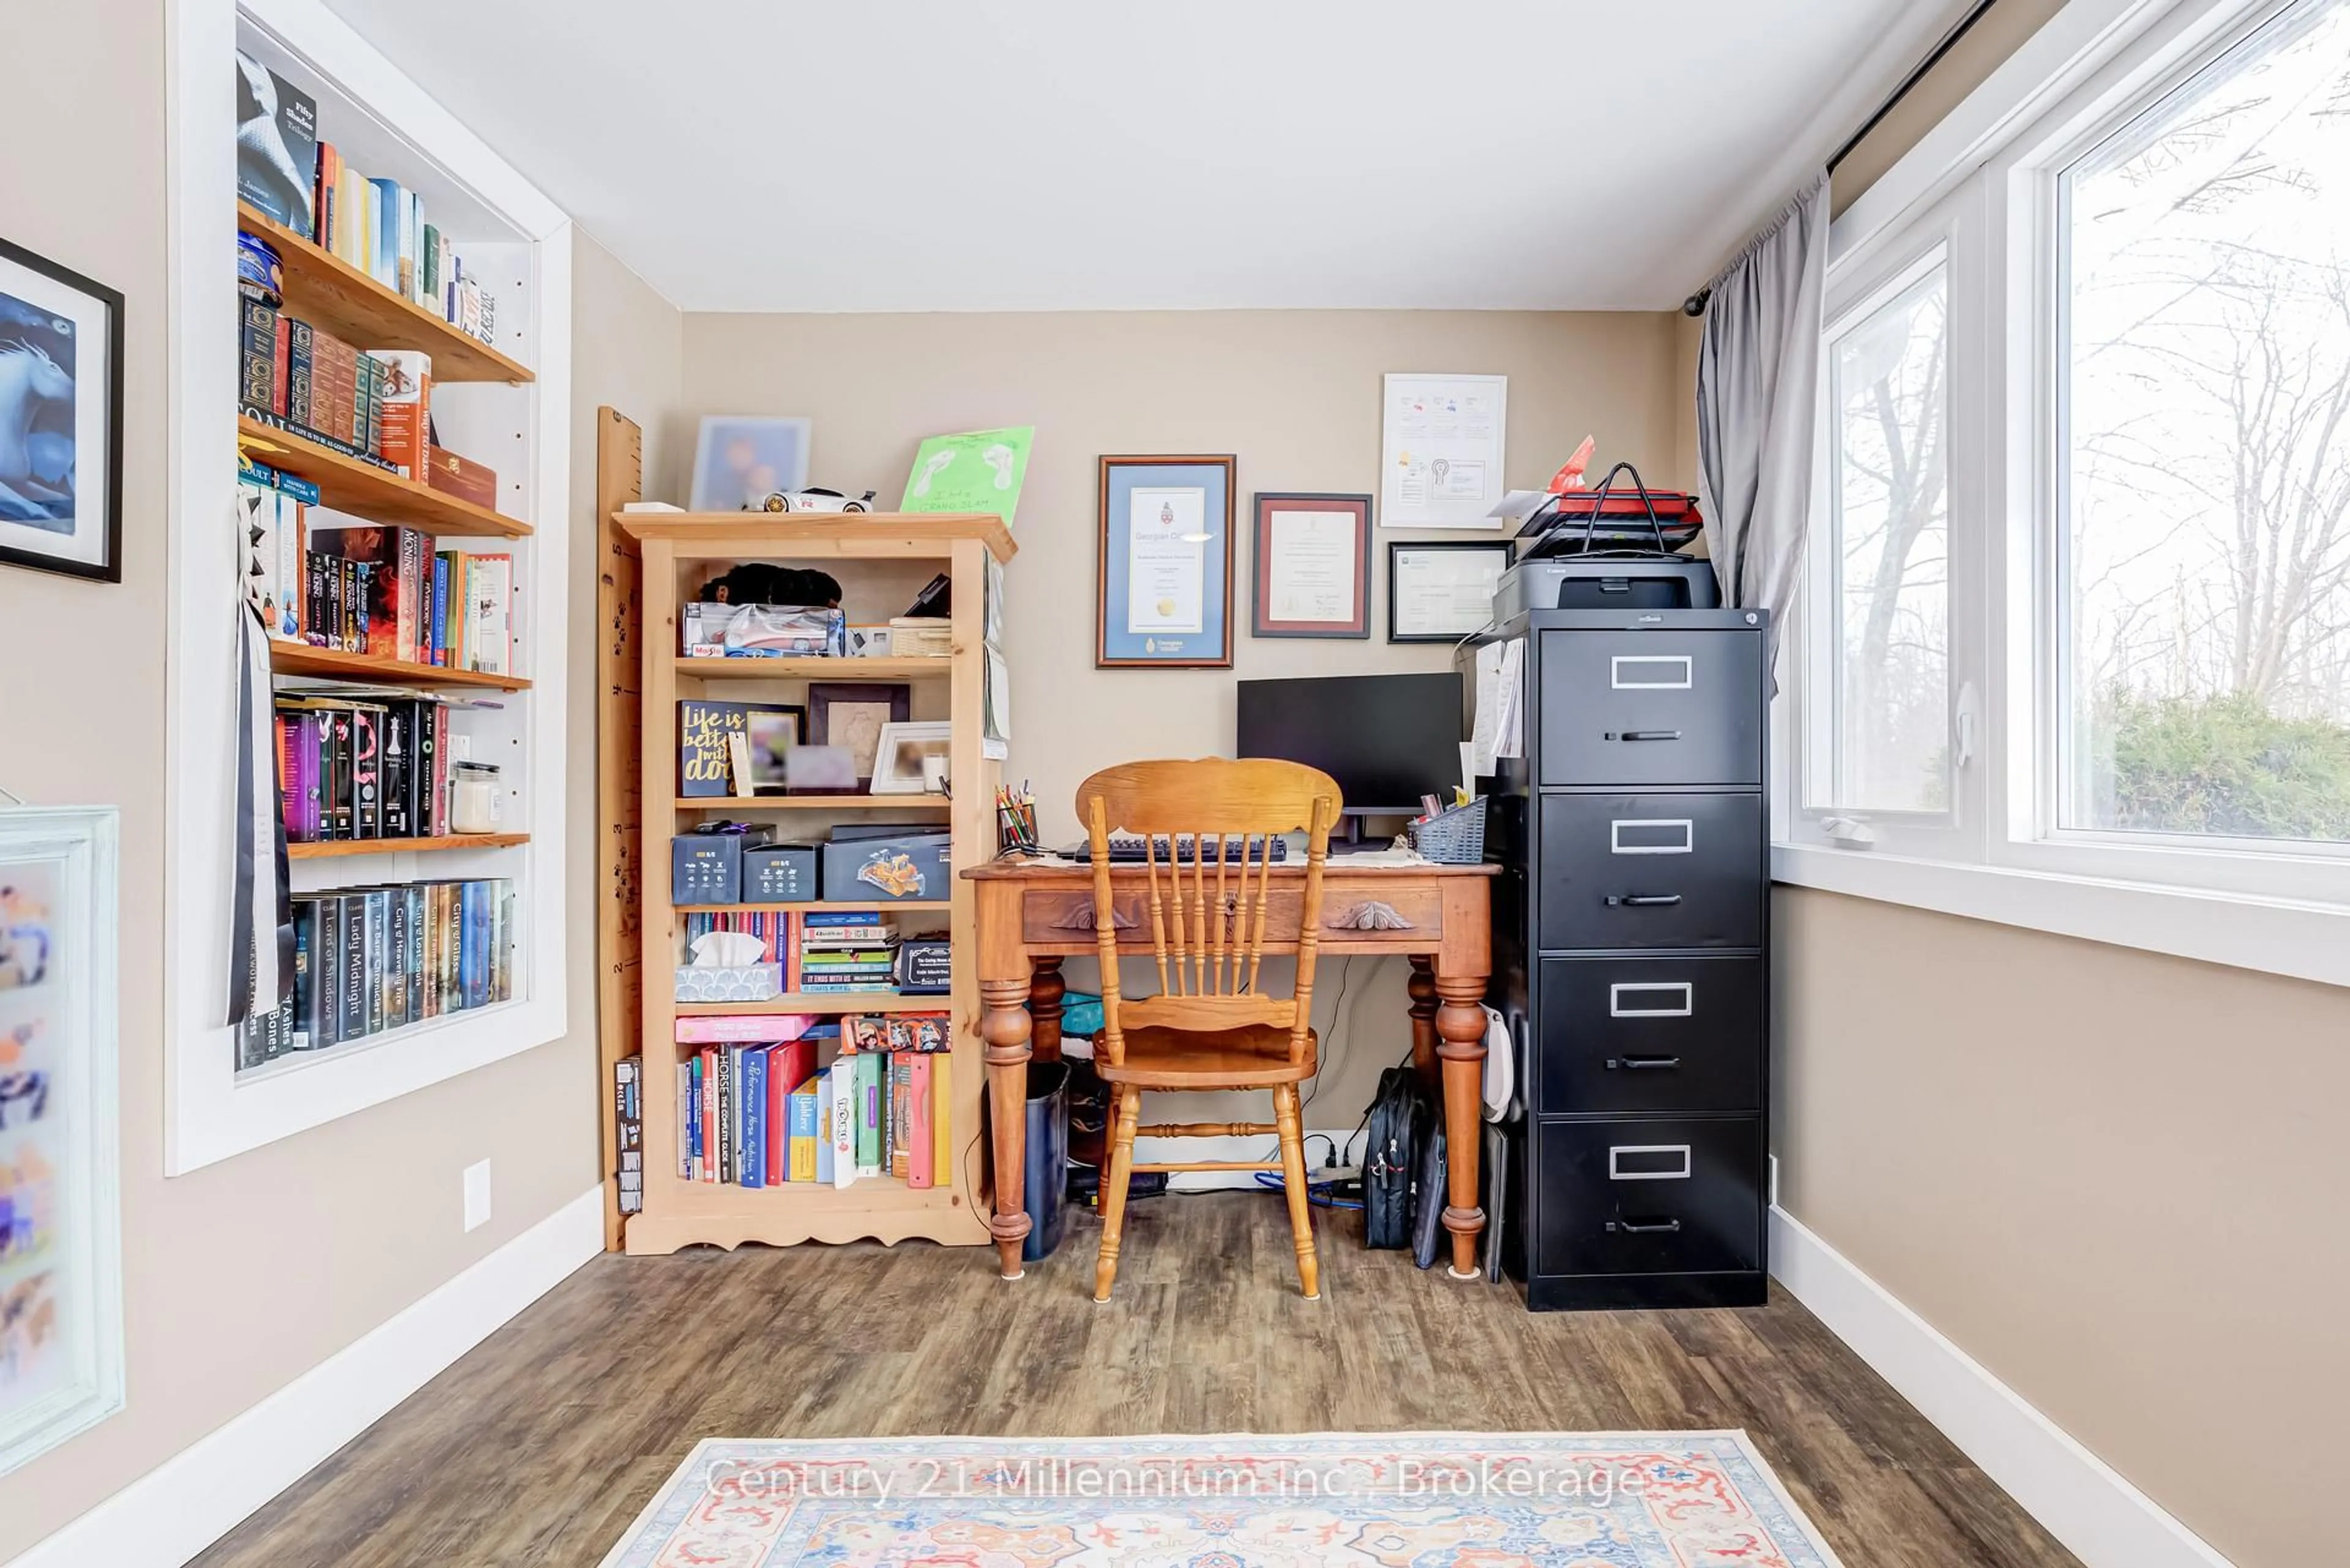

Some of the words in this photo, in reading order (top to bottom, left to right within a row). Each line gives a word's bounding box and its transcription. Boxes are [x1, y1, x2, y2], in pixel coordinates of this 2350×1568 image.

[286, 108, 313, 131] Shades
[296, 102, 313, 120] Fifty
[403, 529, 414, 575] MONING
[684, 705, 723, 734] Life
[726, 710, 745, 730] is
[326, 917, 334, 946] Lord
[394, 908, 404, 928] City
[451, 903, 461, 928] City
[348, 916, 362, 950] Lady
[326, 949, 334, 961] of
[394, 940, 404, 985] Heavenly
[452, 941, 461, 973] Glass
[326, 966, 335, 1020] Shadows
[347, 954, 362, 1016] Midnight
[373, 958, 383, 1013] Chronicles
[267, 1011, 280, 1053] Bones
[282, 1006, 293, 1045] Ashes
[720, 1055, 729, 1093] HORSE
[747, 1066, 761, 1113] Performance
[704, 1078, 713, 1112] HORSE
[747, 1114, 758, 1137] Horse
